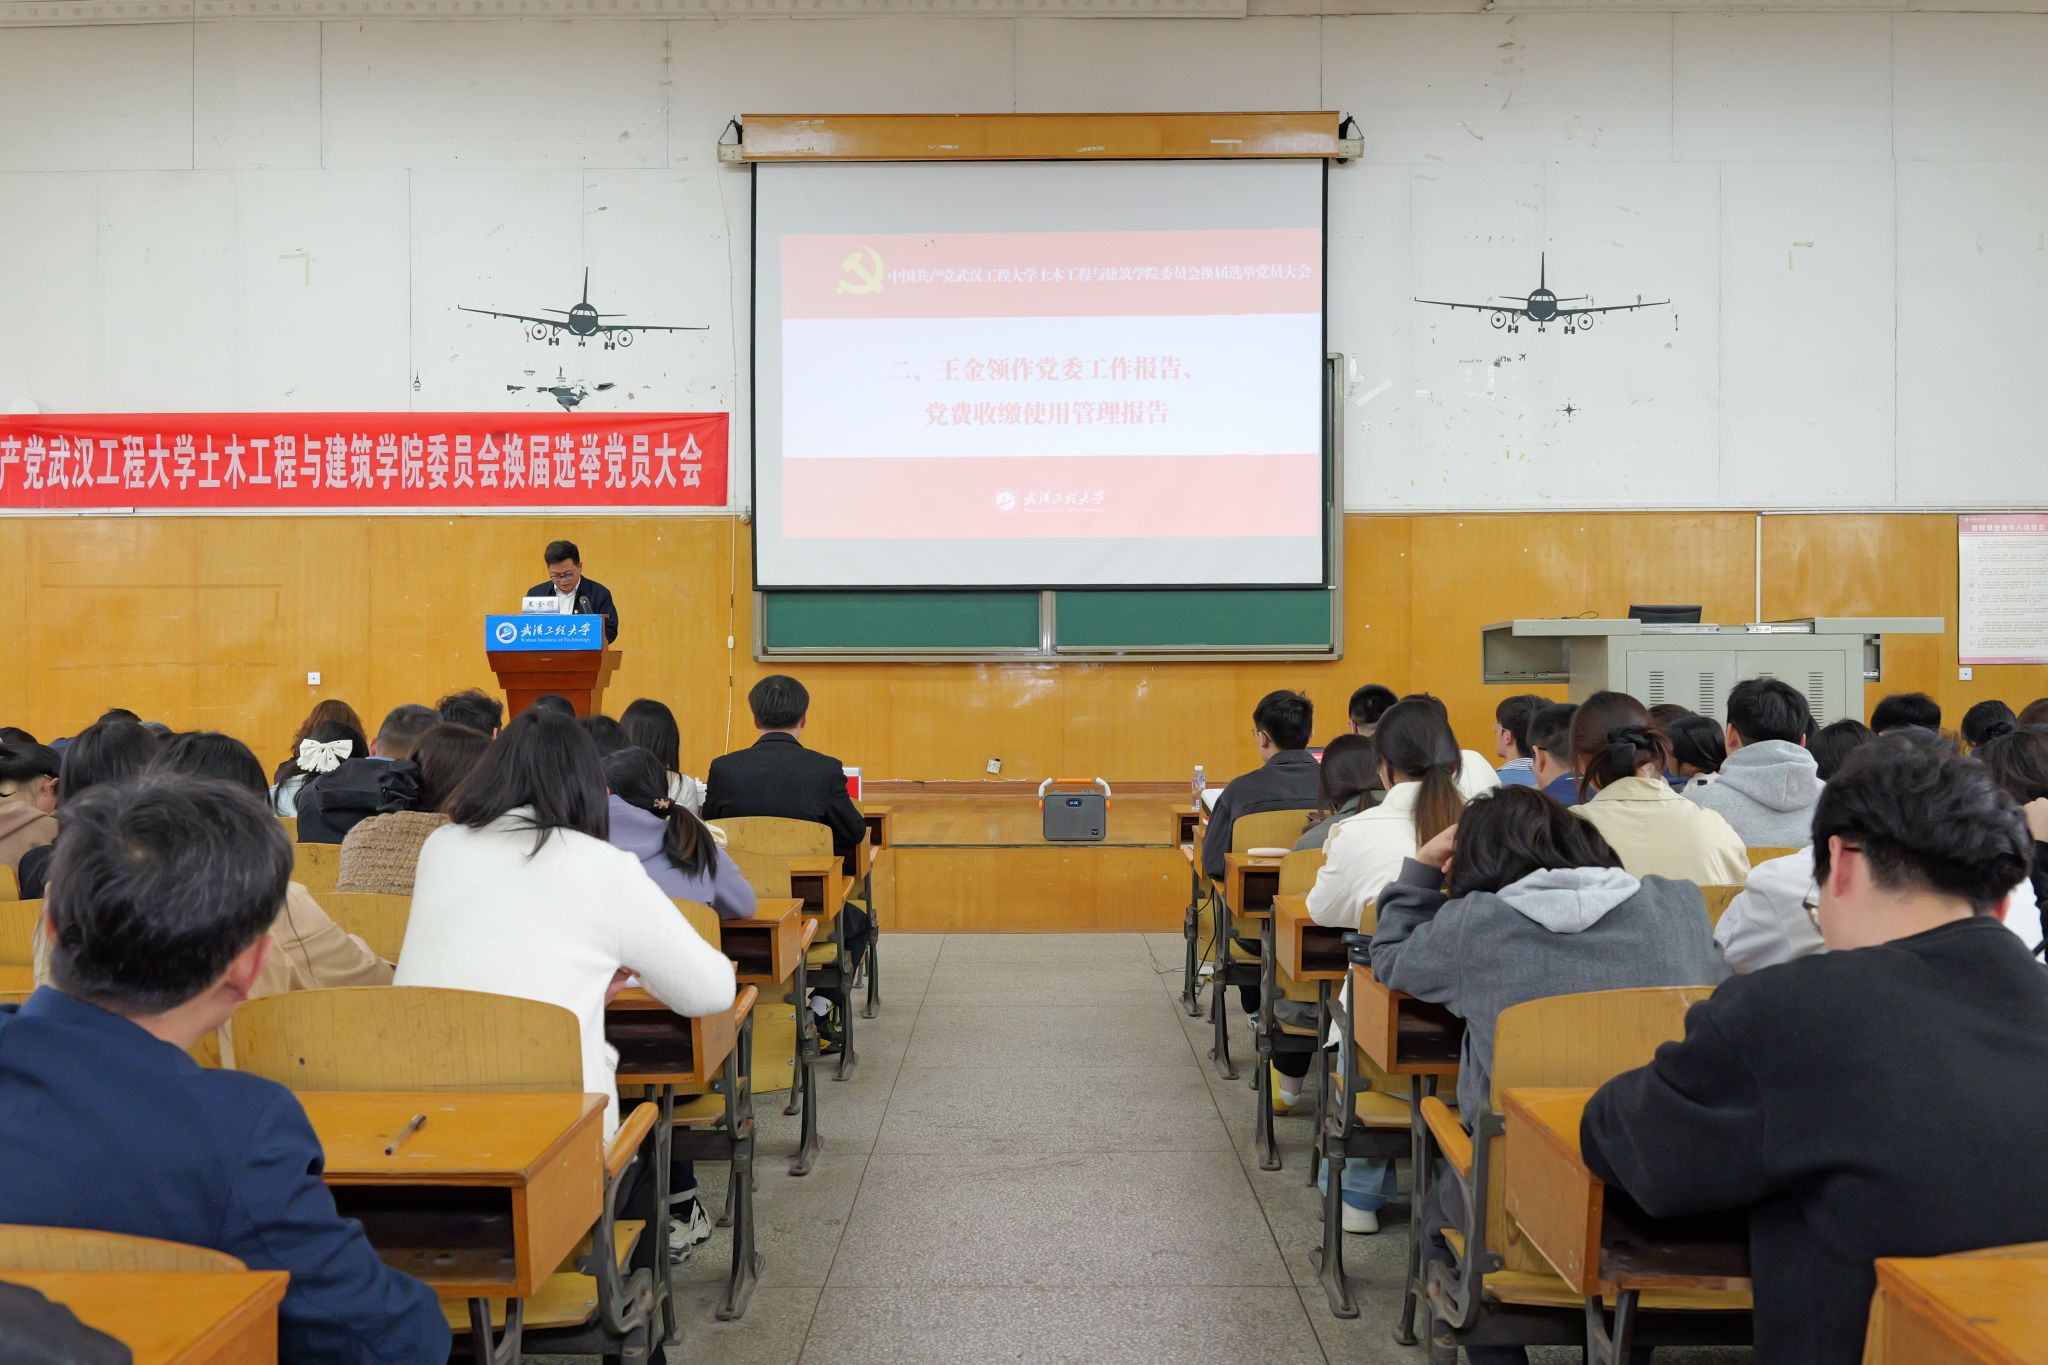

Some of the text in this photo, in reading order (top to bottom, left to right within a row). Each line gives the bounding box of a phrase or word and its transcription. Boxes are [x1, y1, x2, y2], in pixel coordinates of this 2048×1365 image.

[925, 400, 1169, 426] 党费收缴使用管理报告
[0, 433, 702, 491] 产党武汉工程大学土木工程与建筑学院委员会换届选举党员大会
